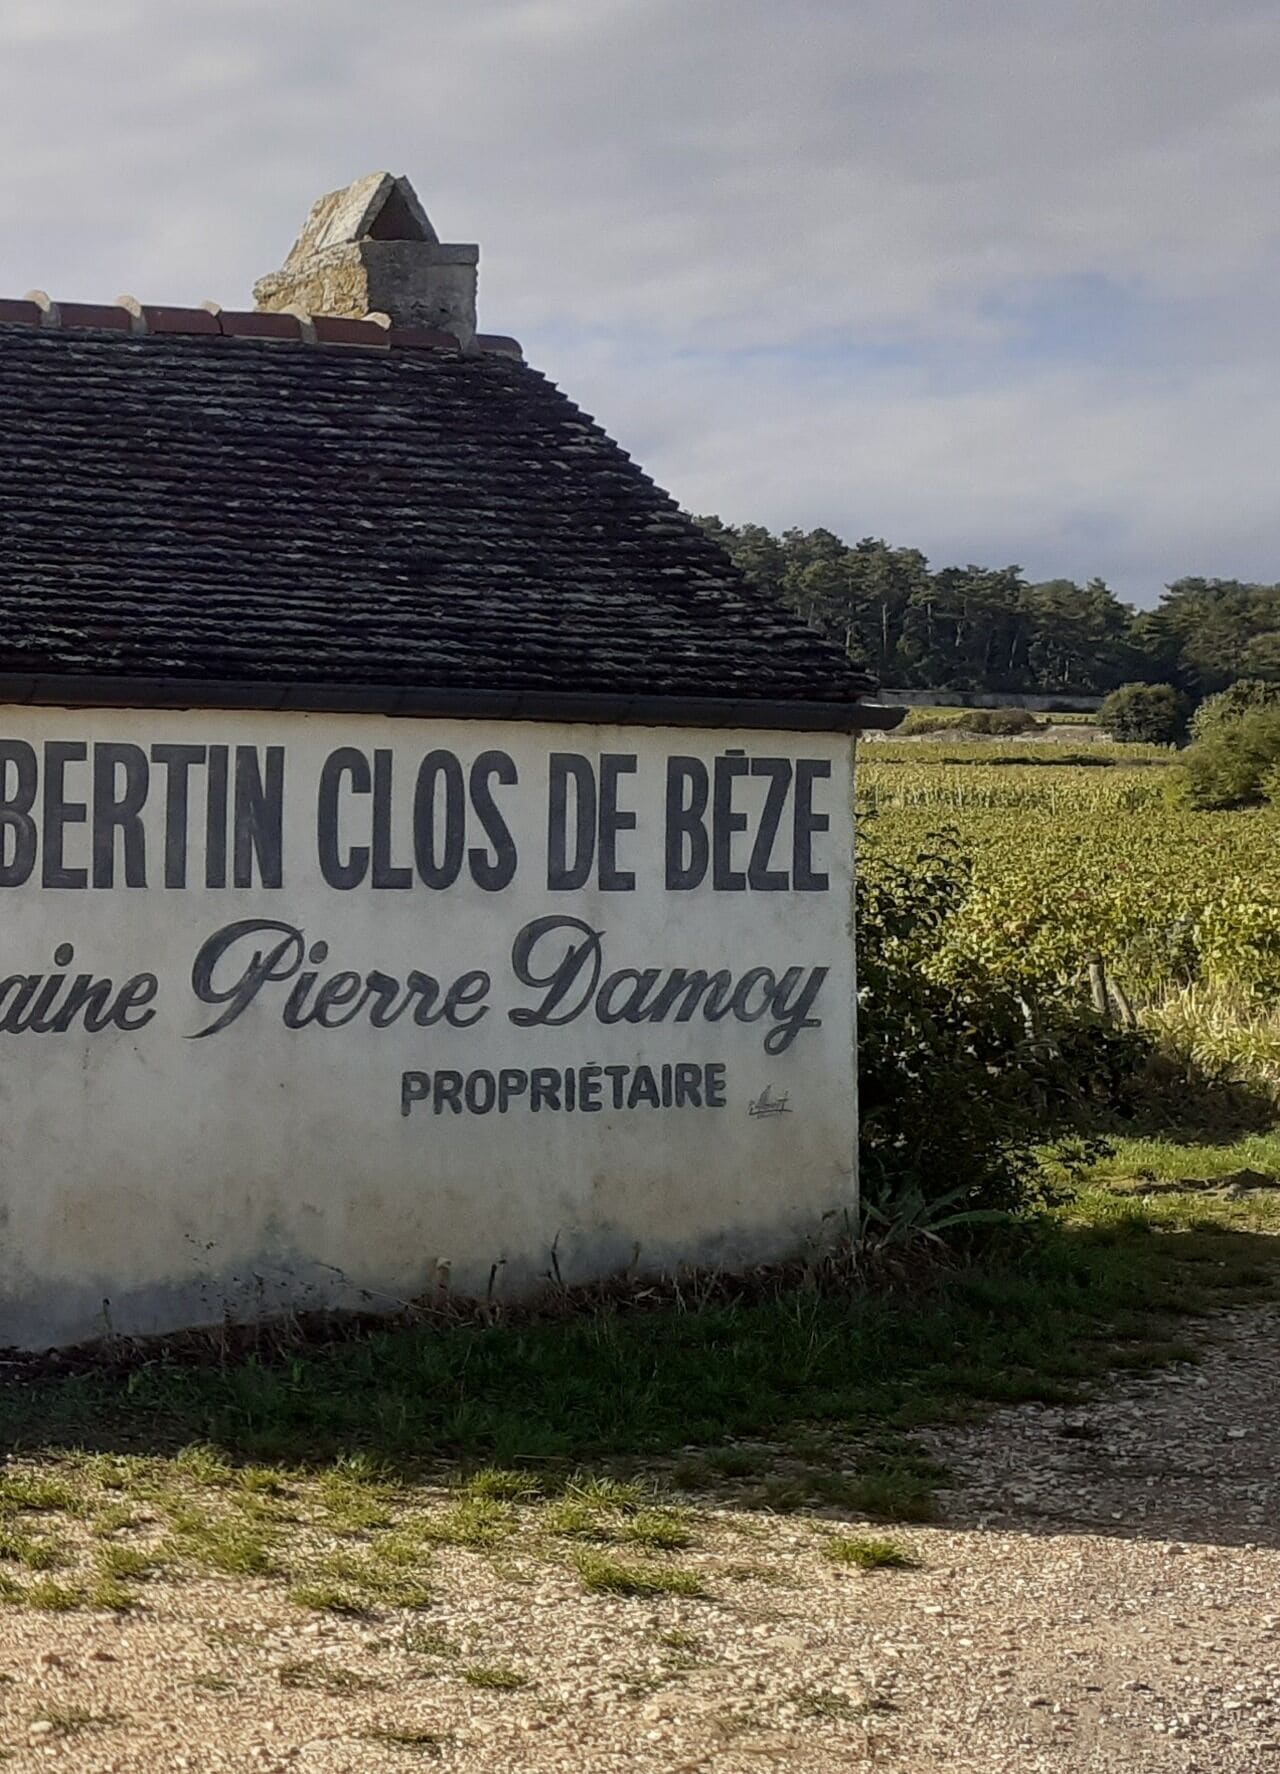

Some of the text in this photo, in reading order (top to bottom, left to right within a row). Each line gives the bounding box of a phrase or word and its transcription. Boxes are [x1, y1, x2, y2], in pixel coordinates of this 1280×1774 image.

[318, 746, 519, 891] CLOS
[547, 752, 637, 891] DE
[182, 918, 492, 1040] Pierre
[508, 914, 830, 1056] Damoy
[400, 1061, 727, 1117] PROPRIÉTAIRE
